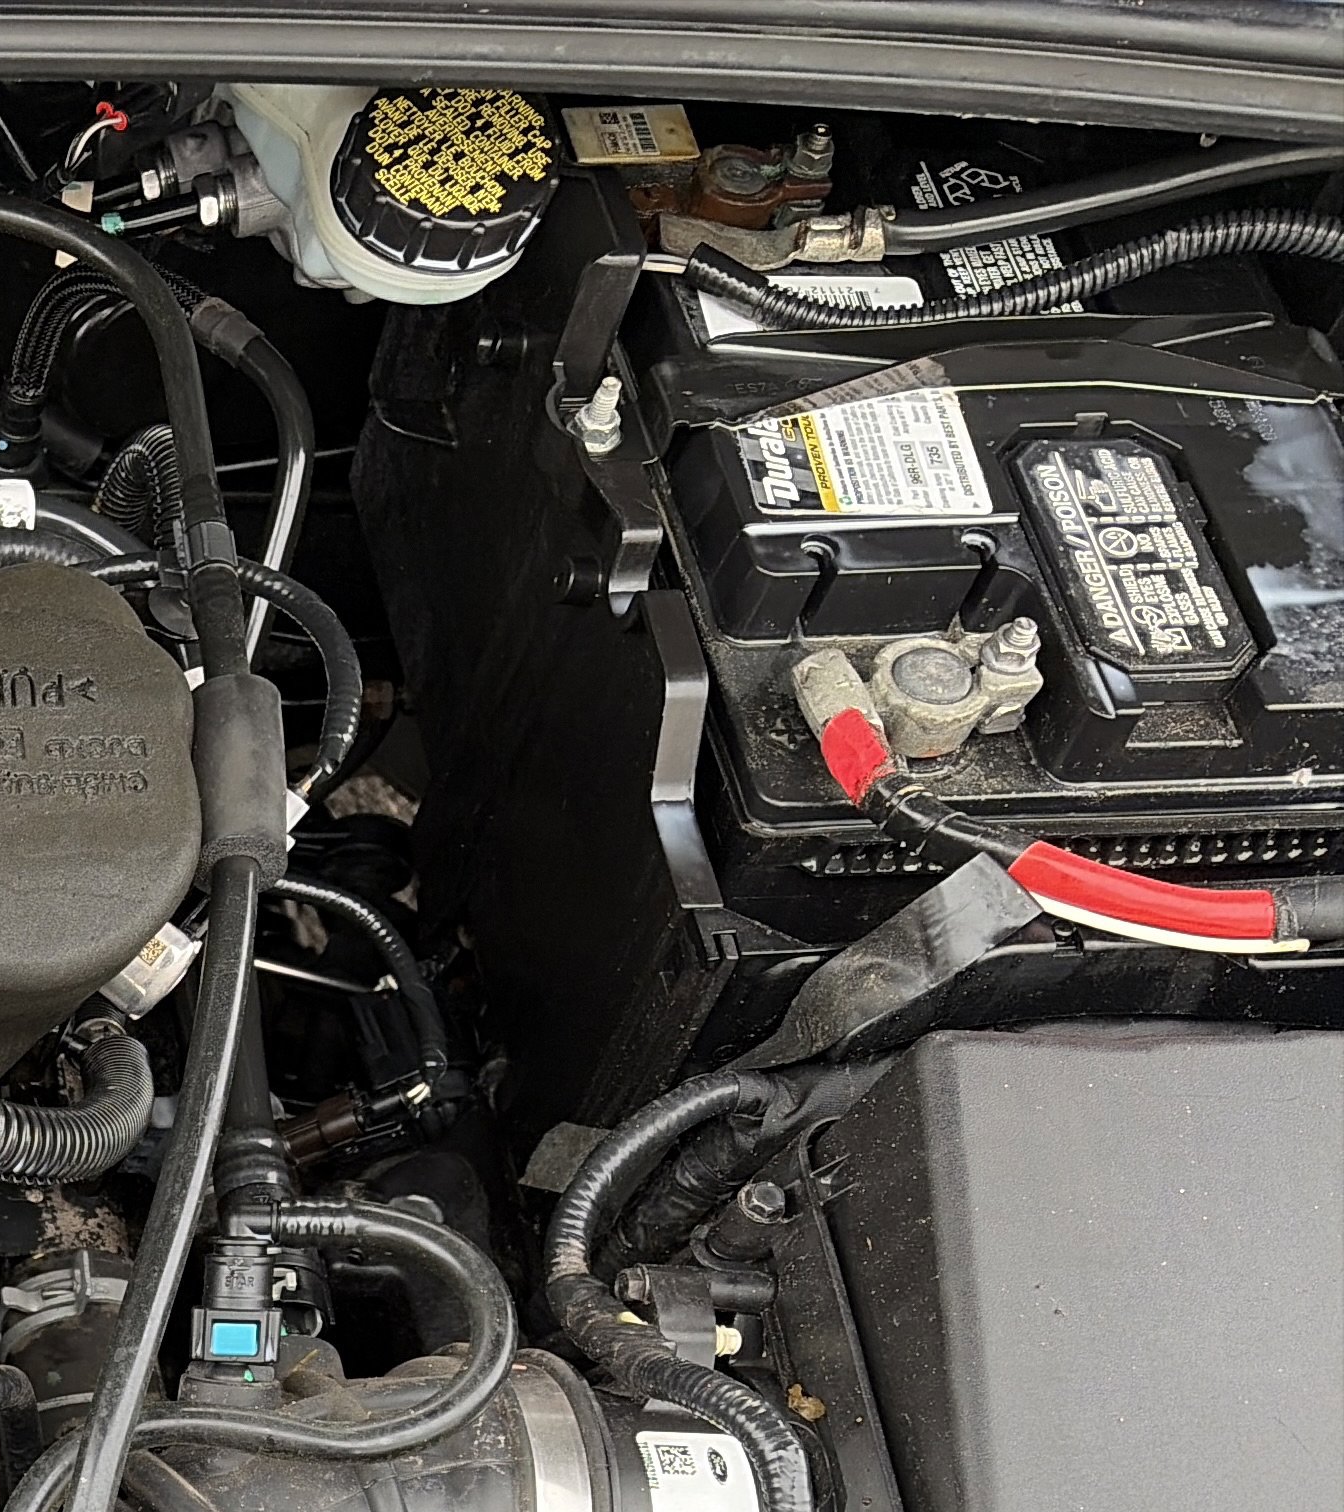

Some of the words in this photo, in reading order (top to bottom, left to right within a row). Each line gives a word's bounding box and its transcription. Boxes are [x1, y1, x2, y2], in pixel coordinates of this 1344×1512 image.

[375, 97, 407, 124] AVANT
[403, 123, 422, 139] DE
[418, 137, 437, 153] LE
[431, 95, 470, 131] SEALED
[493, 98, 528, 130] FILLER
[527, 129, 551, 148] CAP
[497, 89, 544, 129] ARNING:
[369, 109, 408, 145] PLOYER
[407, 144, 431, 165] QUE
[427, 163, 448, 180] DU
[392, 96, 443, 142] NETTOYER
[441, 140, 461, 157] LE
[458, 156, 505, 198] BOUCHON
[450, 95, 476, 116] DOT
[484, 126, 515, 153] FLUID
[512, 152, 545, 181] FROM
[527, 146, 551, 168] USE
[367, 126, 394, 147] DOT
[401, 158, 460, 209] PROVENANT
[390, 164, 448, 215] CONTENANT
[940, 421, 955, 437] BEST
[947, 440, 959, 448] BY
[747, 417, 801, 504] Durala
[808, 444, 830, 488] PROVEN
[899, 444, 923, 484] 96R-DLG
[926, 446, 942, 464] 735
[950, 451, 974, 495] DISTRIBUTED
